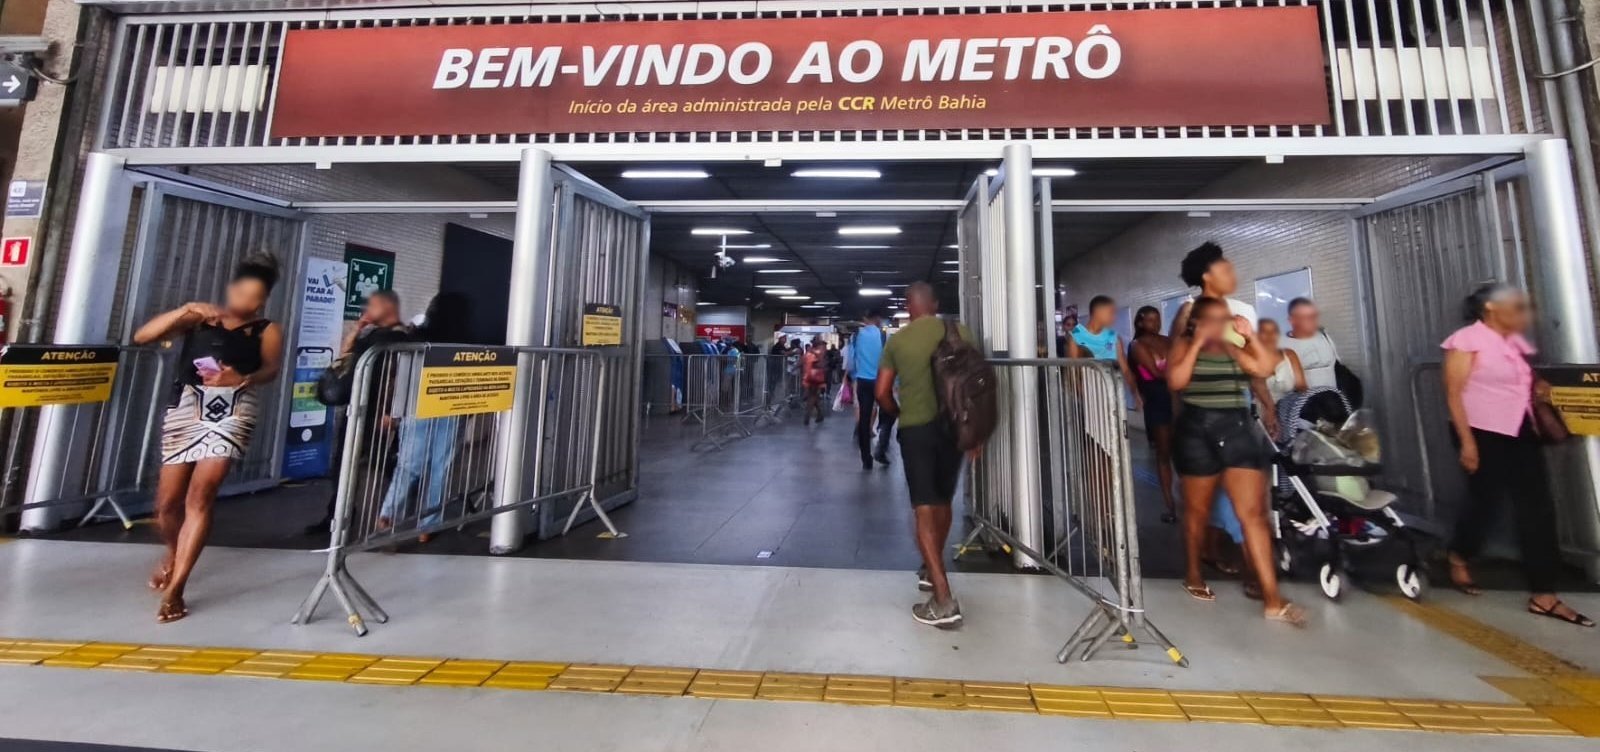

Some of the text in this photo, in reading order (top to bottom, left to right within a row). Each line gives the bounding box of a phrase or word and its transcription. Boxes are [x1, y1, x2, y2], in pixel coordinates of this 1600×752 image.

[432, 24, 1122, 90] BEM-VINDO AO METRÔ
[568, 94, 986, 115] Início da área administrada pela CCR Metrô Bahia
[306, 286, 326, 295] FICAR
[41, 350, 97, 361] ATENÇÃO
[453, 349, 497, 362] ATENÇÃO
